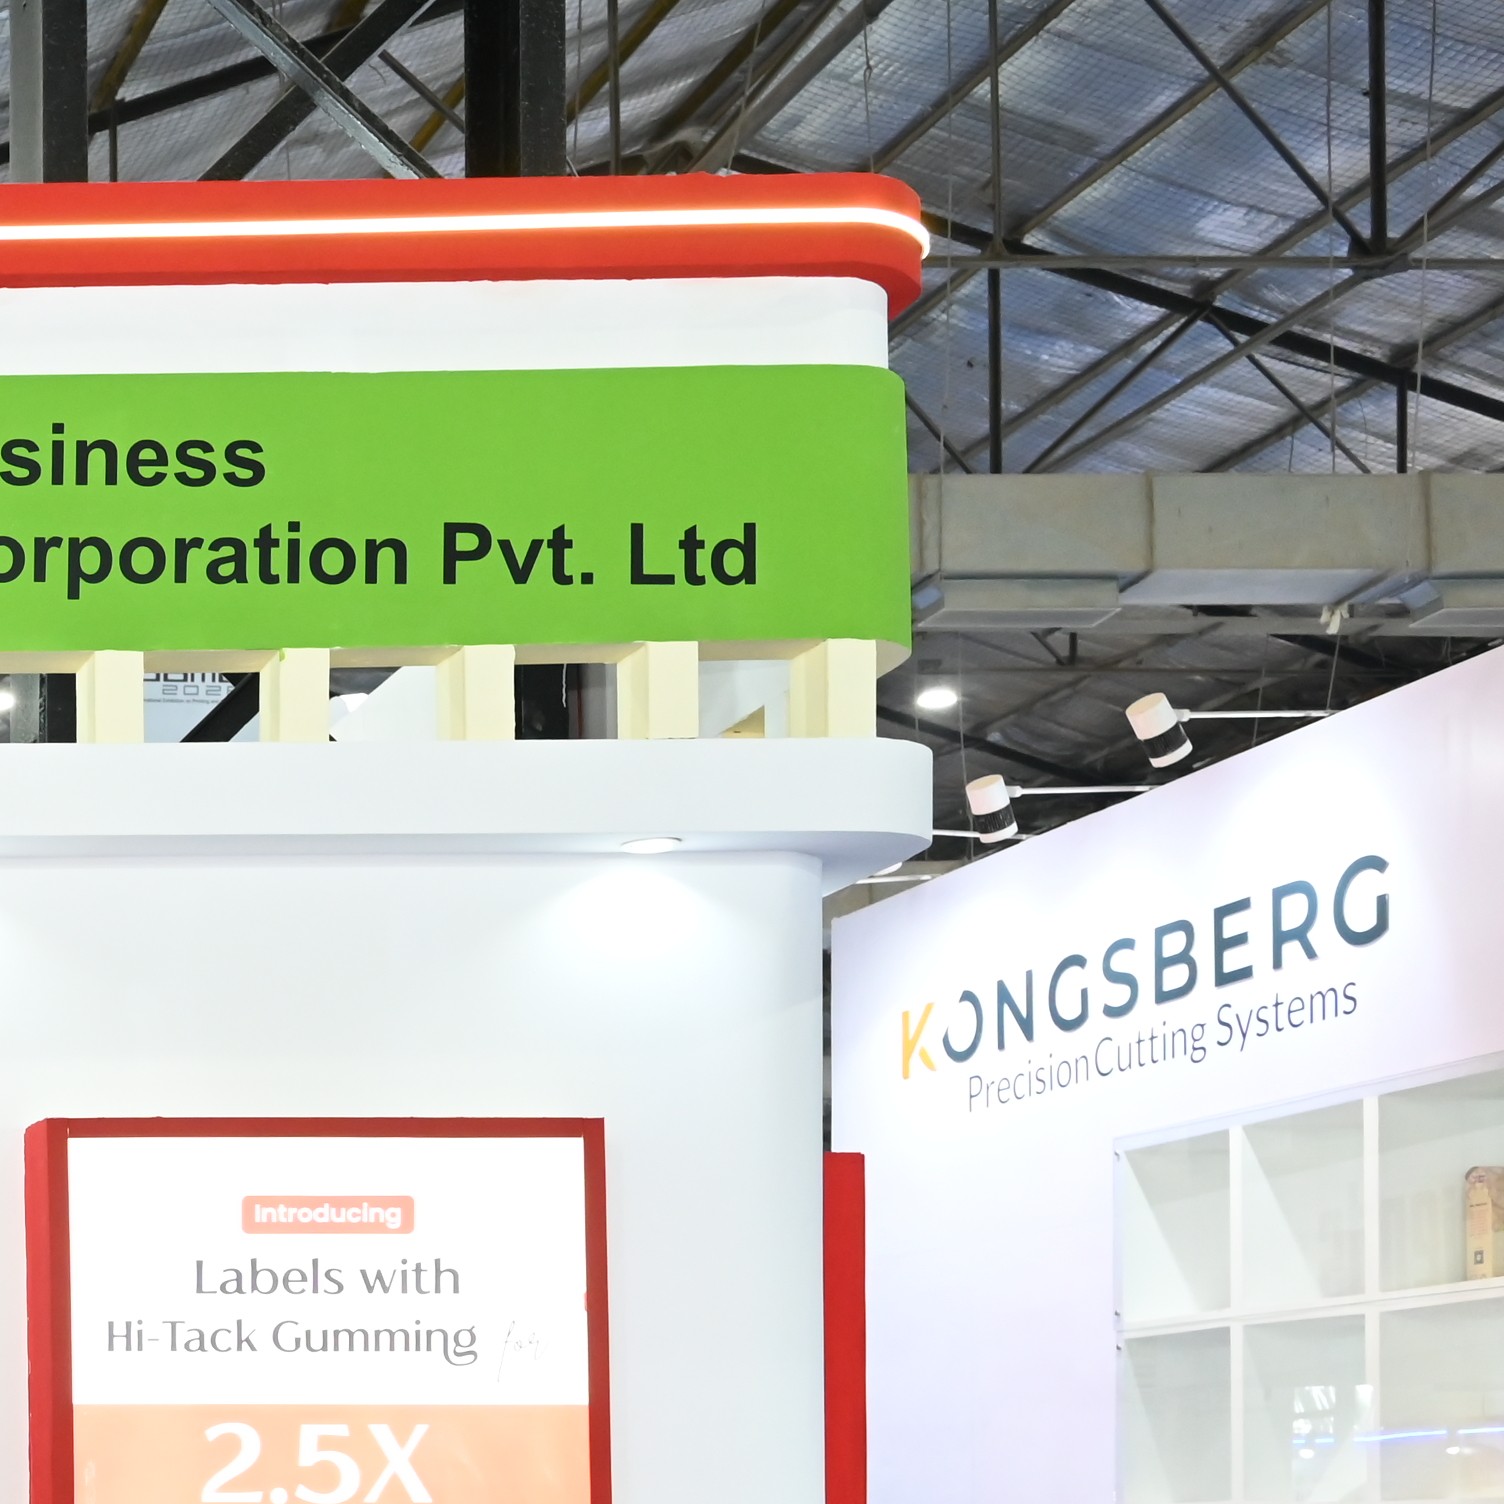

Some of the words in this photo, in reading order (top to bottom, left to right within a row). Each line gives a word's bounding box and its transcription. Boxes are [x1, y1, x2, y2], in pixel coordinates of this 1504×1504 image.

[442, 521, 595, 586] Pvt.
[629, 521, 758, 586] Ltd
[900, 854, 1390, 1080] KONGSBERG
[1215, 982, 1358, 1052] Systems
[253, 1202, 402, 1229] Introducing
[194, 1257, 345, 1295] Labels
[359, 1257, 461, 1295] with
[106, 1318, 259, 1353] Hi-Tack
[271, 1318, 479, 1367] Gumming
